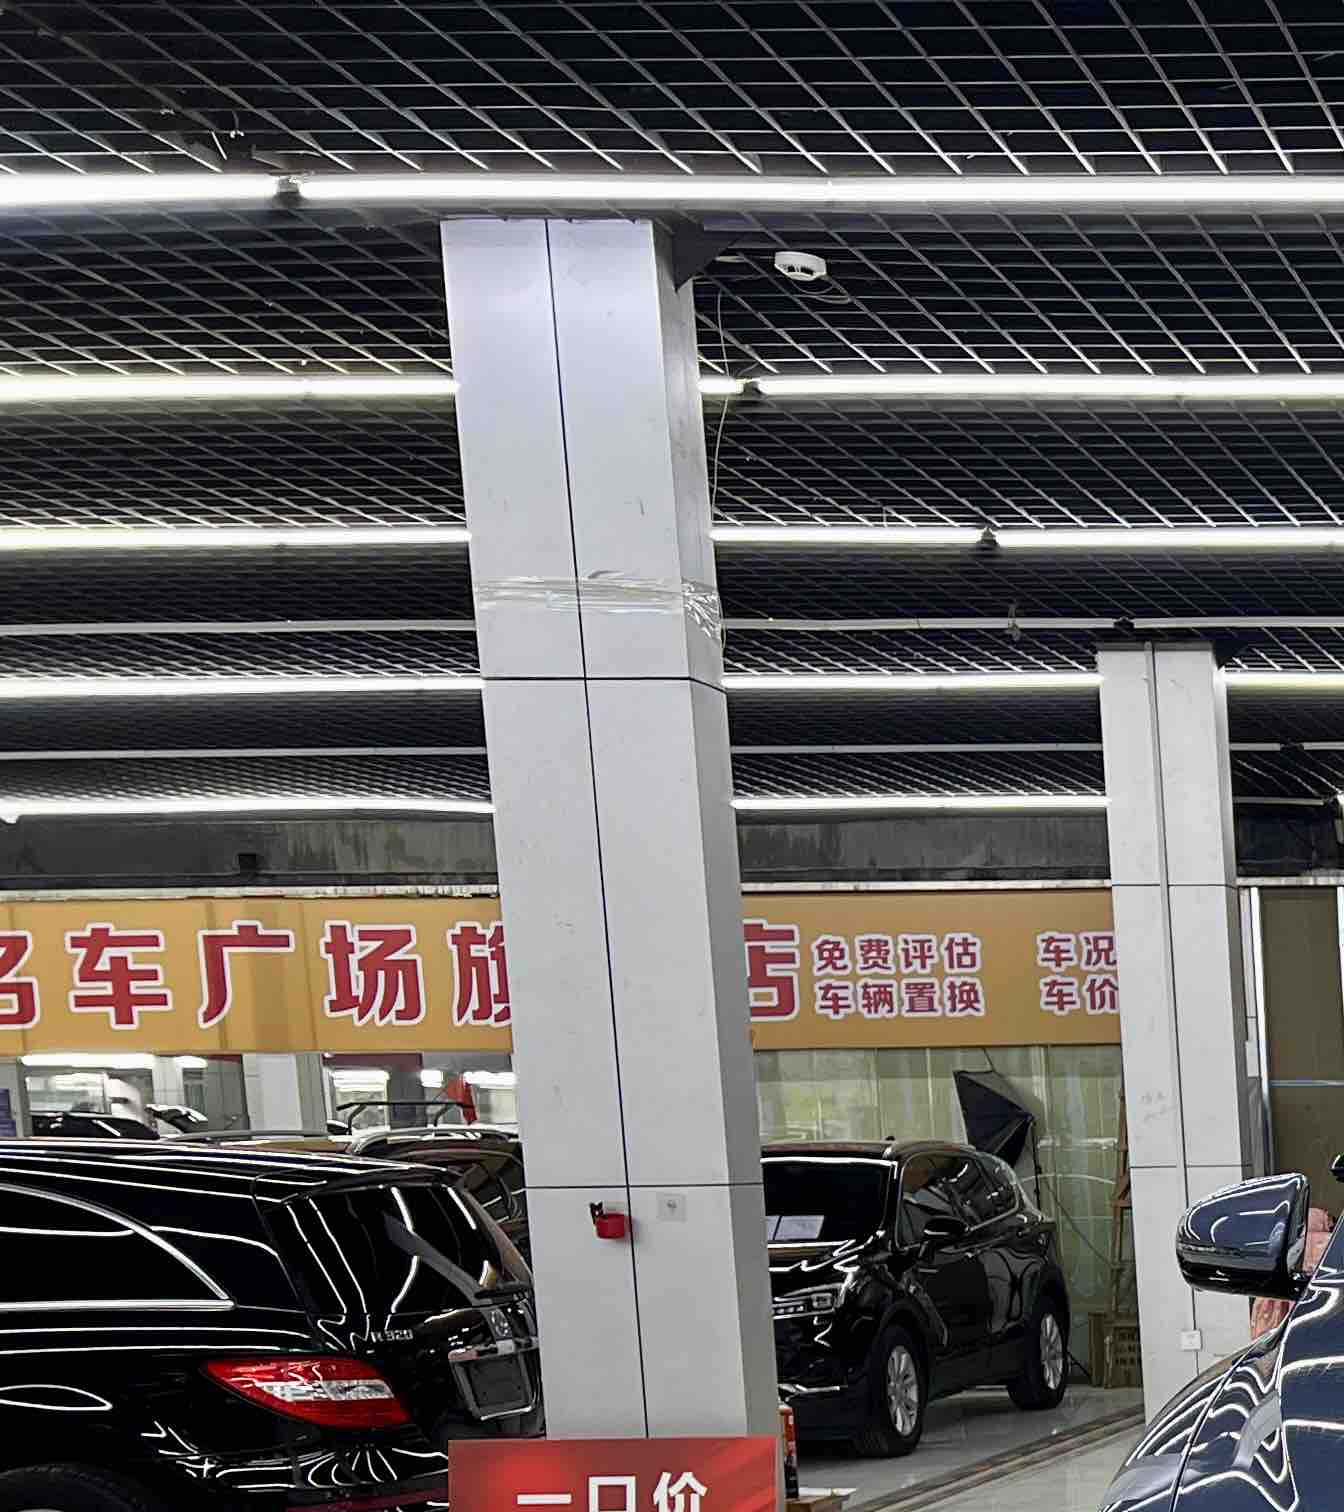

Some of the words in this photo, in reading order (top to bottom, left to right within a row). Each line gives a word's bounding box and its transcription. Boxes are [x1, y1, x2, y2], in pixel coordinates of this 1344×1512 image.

[812, 931, 982, 976] 免费评估
[814, 977, 985, 1021] 车辆置换
